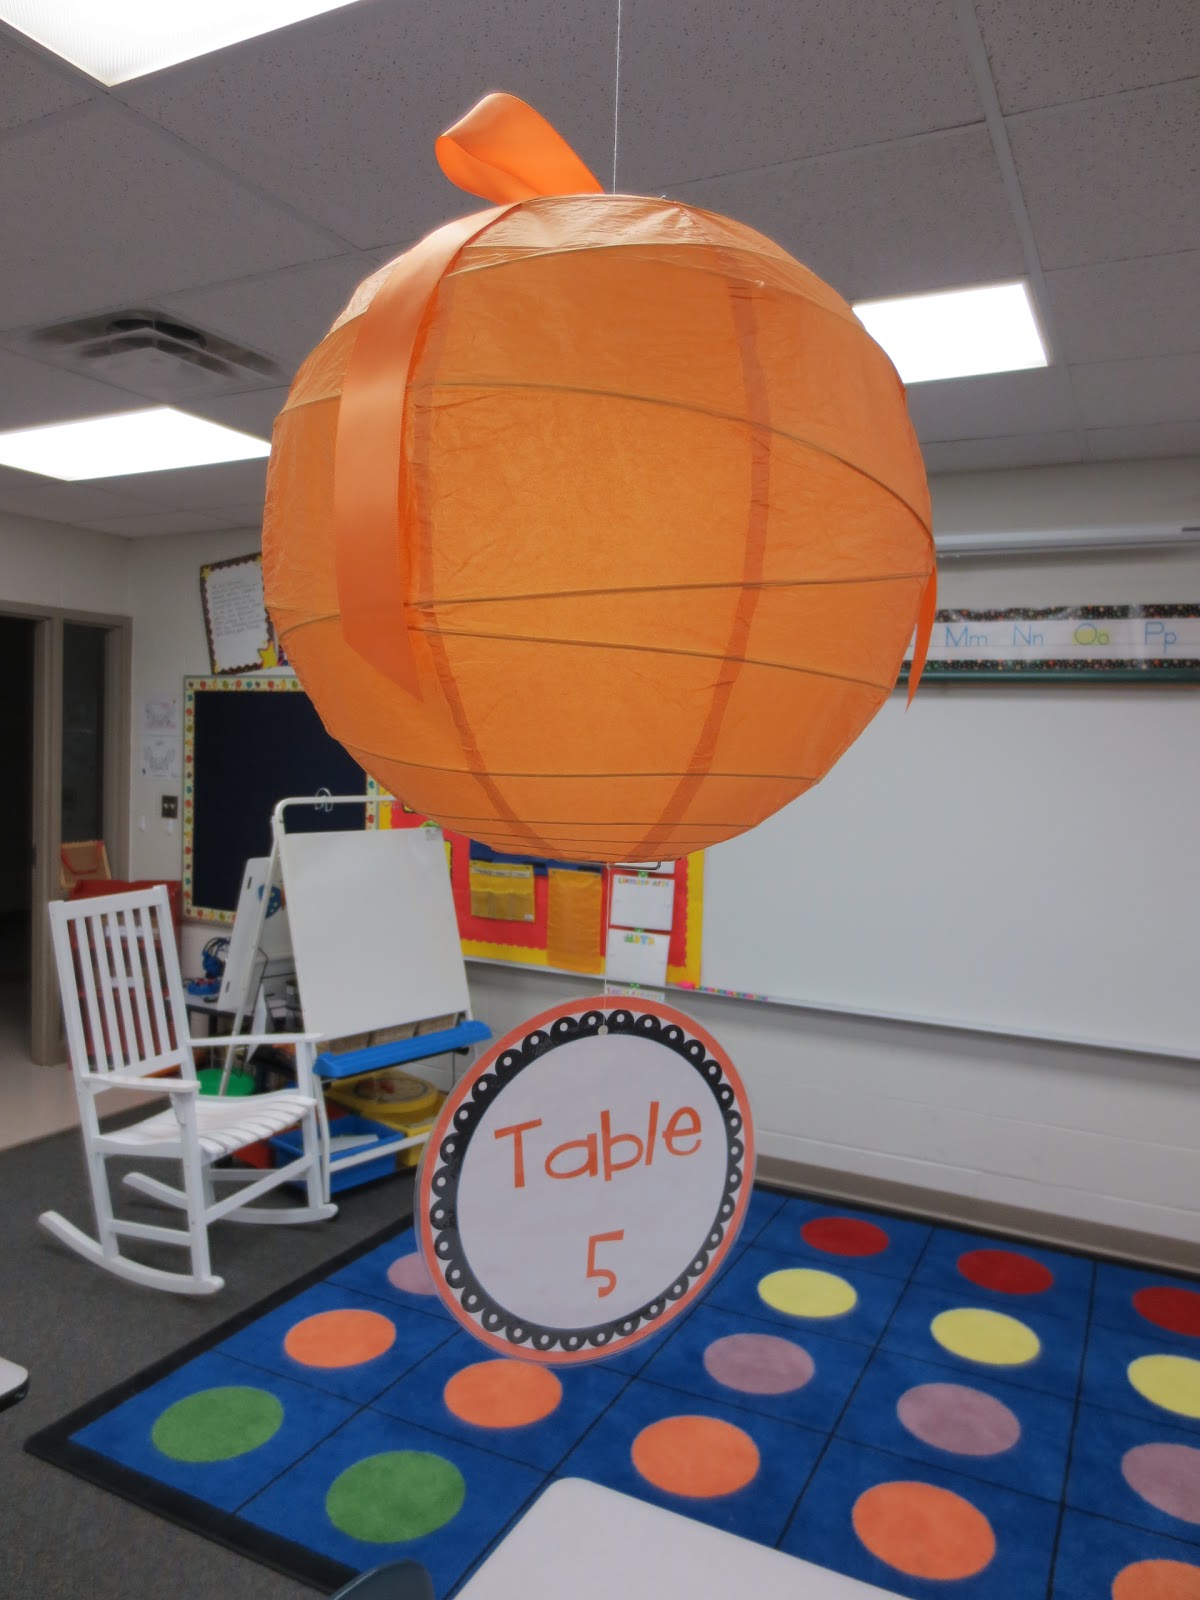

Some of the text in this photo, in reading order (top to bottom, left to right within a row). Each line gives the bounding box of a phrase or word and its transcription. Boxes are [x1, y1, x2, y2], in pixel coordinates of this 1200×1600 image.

[945, 621, 1177, 654] Mm Nn Oo Pp
[494, 1101, 702, 1188] Table
[586, 1229, 625, 1298] 5
